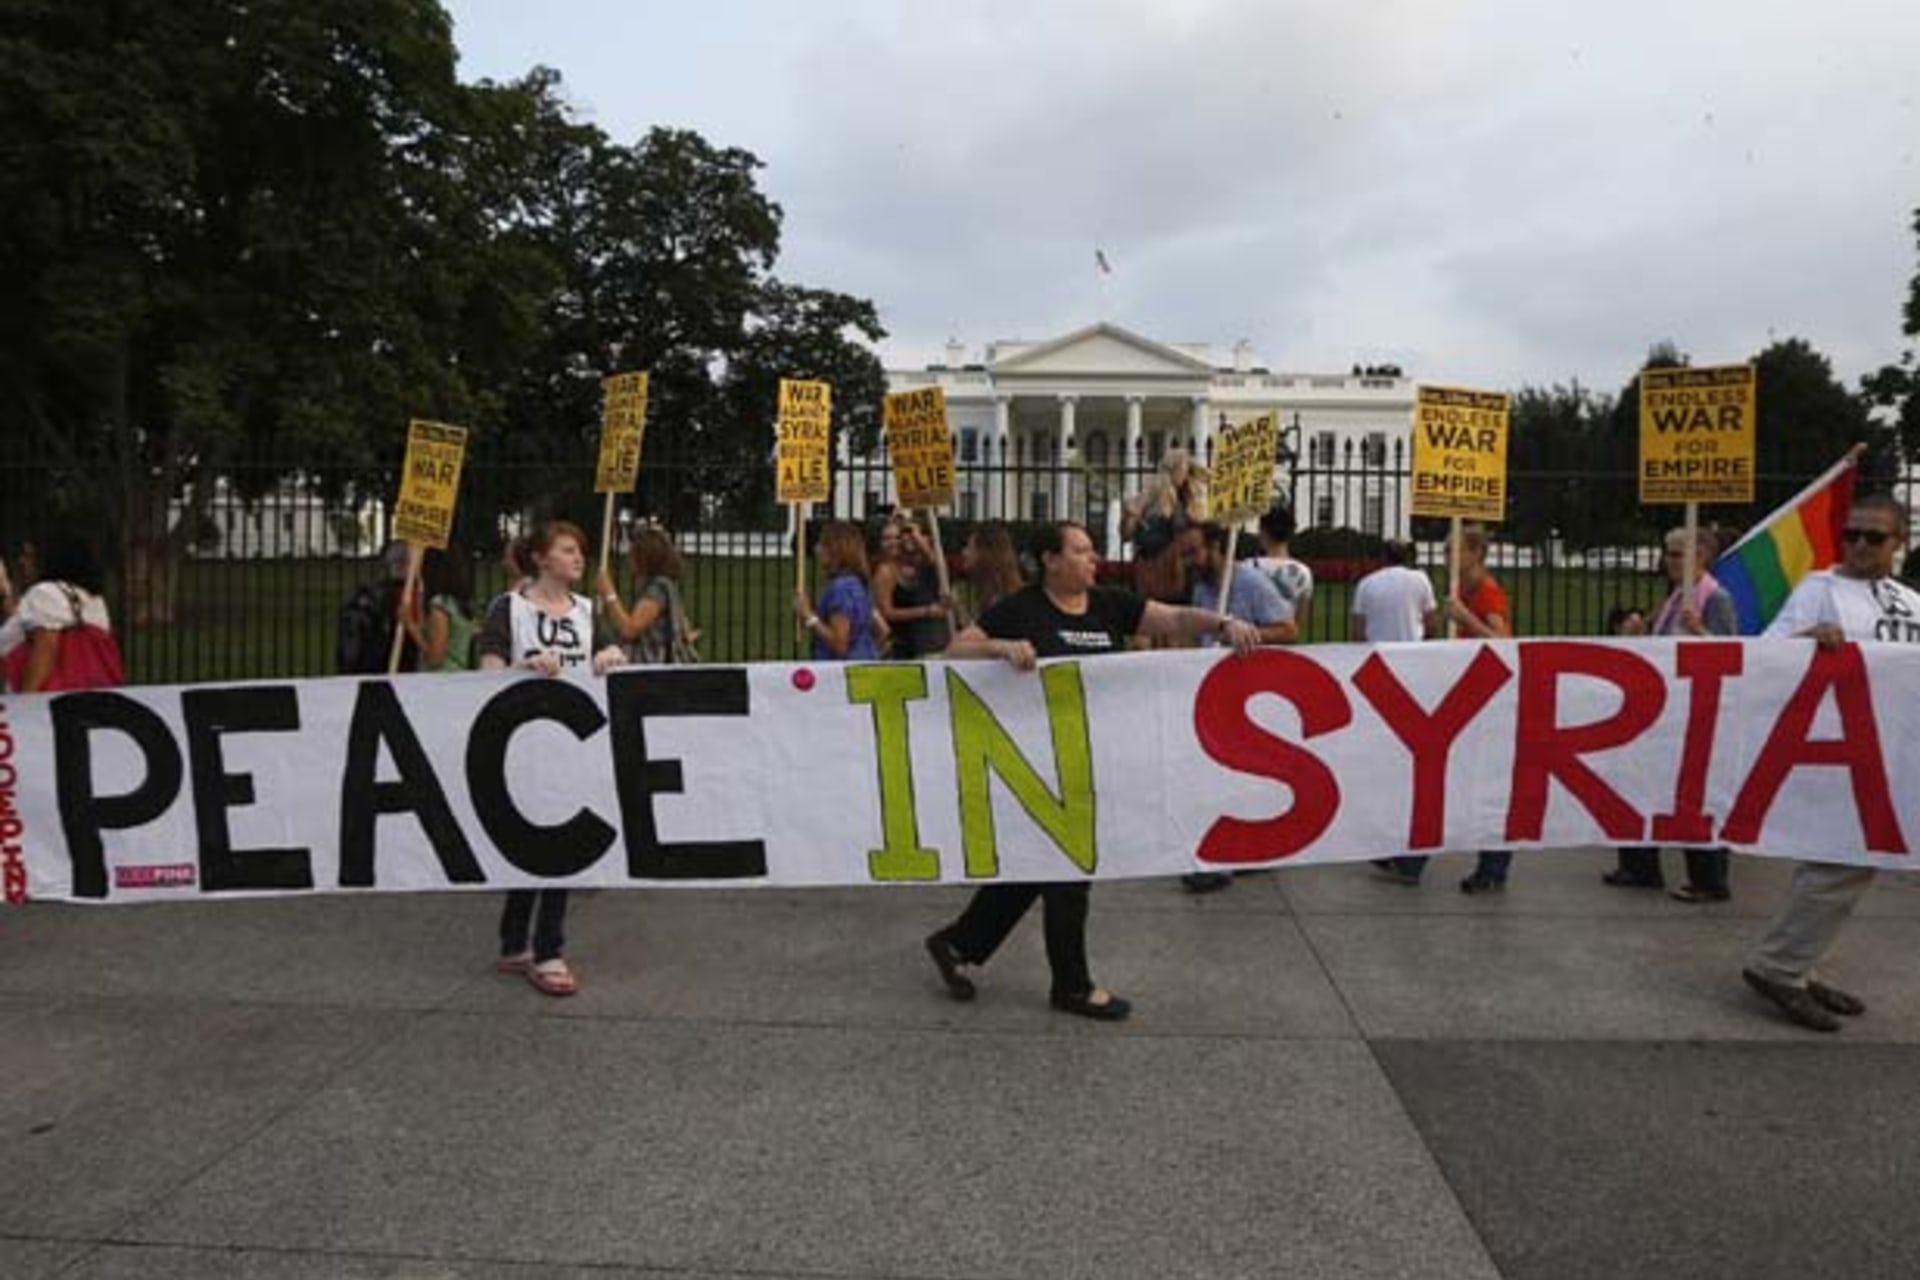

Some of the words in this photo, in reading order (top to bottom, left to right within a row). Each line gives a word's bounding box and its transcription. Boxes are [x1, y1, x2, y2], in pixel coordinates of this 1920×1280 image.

[889, 390, 935, 414] WAR
[1647, 387, 1748, 407] ENDLESS
[1421, 407, 1502, 428] ENDLESS
[1651, 405, 1743, 433] WAR
[1425, 422, 1497, 453] WAR
[1673, 438, 1719, 455] FOR
[799, 460, 822, 483] LE
[1443, 455, 1476, 473] FOR
[1645, 457, 1748, 478] EMPIRE
[914, 466, 950, 490] LIE
[1416, 472, 1500, 496] EMPIRE
[537, 610, 580, 649] US
[50, 669, 766, 898] PEACE
[844, 661, 1096, 881] IN
[1194, 640, 1909, 864] SYRIA
